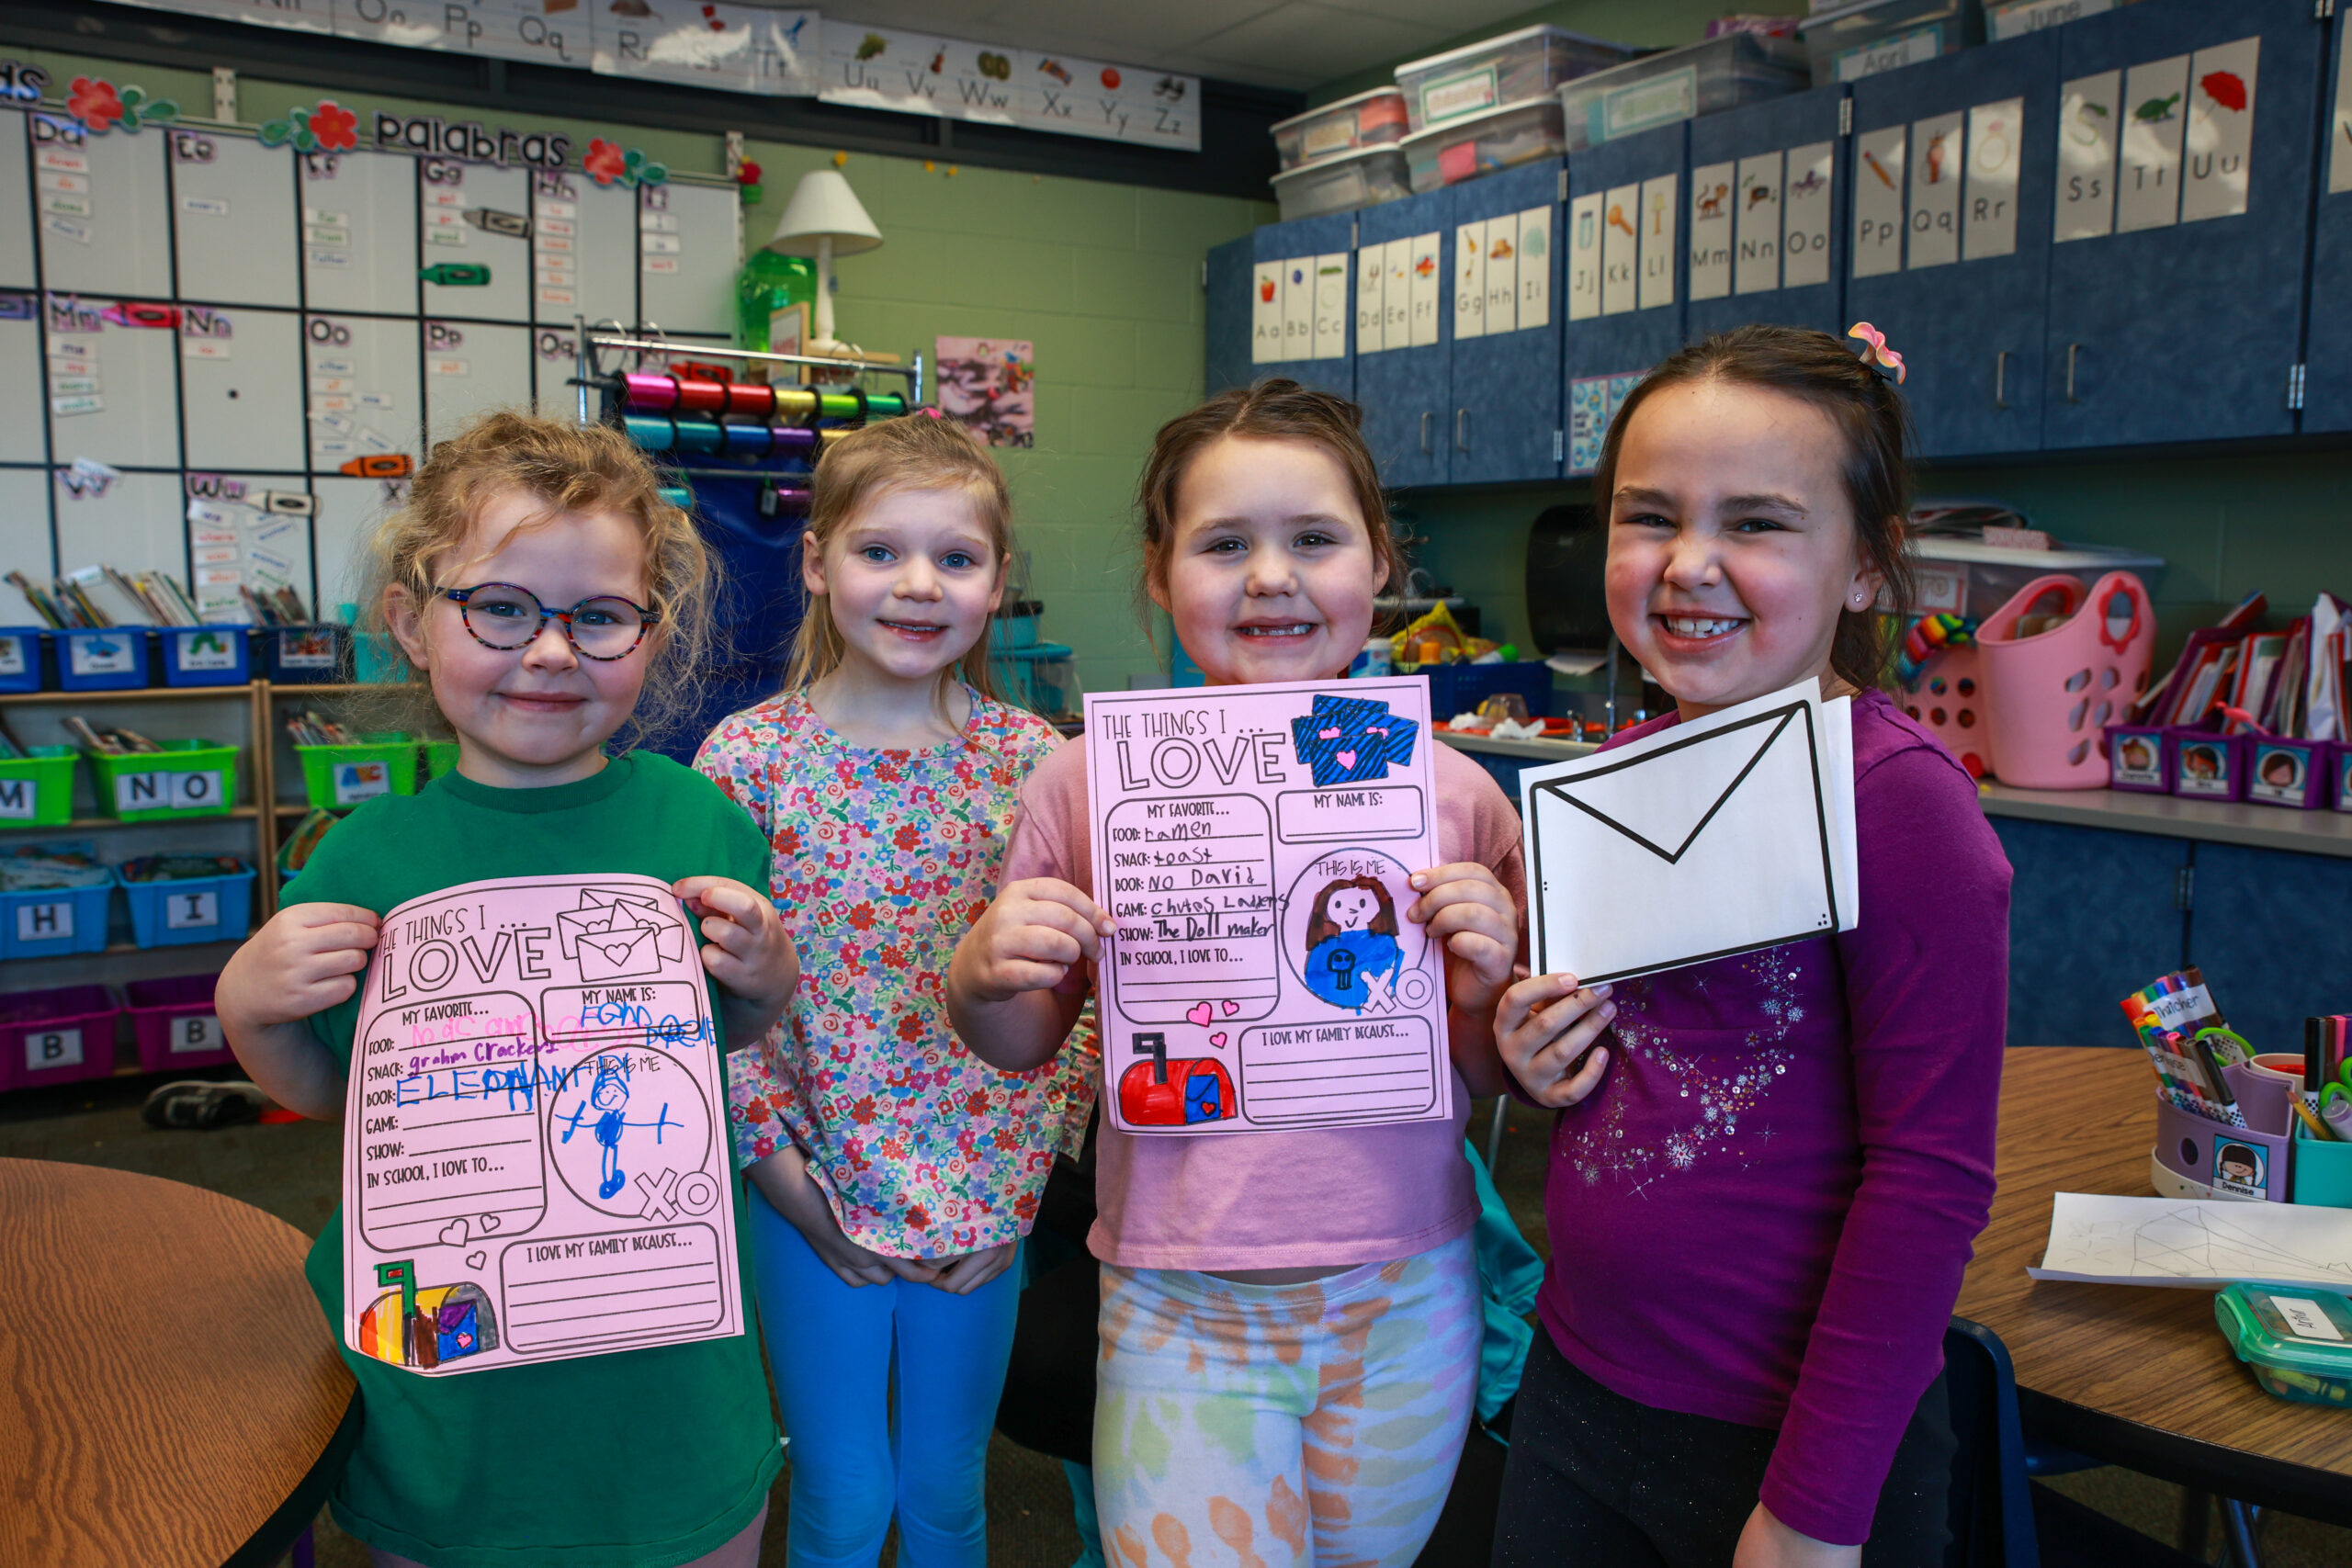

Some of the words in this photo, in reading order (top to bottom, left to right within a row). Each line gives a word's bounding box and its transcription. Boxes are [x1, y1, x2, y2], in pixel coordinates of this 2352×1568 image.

[2024, 3, 2082, 32] June
[444, 4, 483, 47] Pp
[517, 16, 572, 62] Qq
[844, 62, 879, 91] Uu
[906, 71, 935, 99] Vv
[958, 78, 1009, 108] Ww
[1043, 91, 1072, 119] Xx
[1099, 98, 1129, 136] Yy
[1155, 107, 1182, 135] Zz
[1861, 42, 1911, 74] April
[378, 114, 571, 169] palabras
[186, 309, 232, 336] Nn
[310, 320, 350, 345] Oo
[429, 324, 462, 345] Pp
[190, 476, 245, 500] Ww
[1102, 713, 1131, 740] THE
[1141, 709, 1210, 738] THINGS
[1218, 708, 1227, 735] I
[1117, 733, 1286, 792] LOVE
[0, 783, 24, 809] M
[131, 774, 157, 801] N
[185, 774, 209, 800] O
[1314, 793, 1334, 808] MY
[1337, 792, 1366, 807] NAME
[1369, 791, 1384, 807] IS:
[1148, 804, 1167, 818] MY
[1170, 800, 1230, 818] FAVORITE...
[1113, 828, 1141, 842] FOOD:
[1114, 852, 1150, 867] SNACK:
[1316, 860, 1347, 877] THIS
[1350, 860, 1363, 875] IS
[1366, 858, 1386, 875] ME
[1114, 877, 1145, 892] BOOK:
[33, 906, 57, 931] H
[186, 894, 204, 919] I
[1116, 902, 1148, 918] GAME:
[379, 927, 399, 958] THE
[405, 908, 469, 946] THINGS
[478, 904, 485, 930] I
[1118, 927, 1154, 942] SHOW:
[1153, 919, 1180, 938] The
[1186, 911, 1220, 942] Doll
[382, 927, 551, 1004] LOVE
[1120, 951, 1131, 965] IN
[1135, 949, 1177, 965] SCHOOL,
[1181, 949, 1185, 964] I
[1188, 948, 1211, 963] LOVE
[1214, 947, 1243, 962] TO...
[582, 989, 602, 1005] MY
[606, 987, 637, 1003] NAME
[641, 987, 656, 1001] IS:
[1360, 964, 1434, 1014] XO
[402, 1009, 421, 1026] MY
[424, 1000, 490, 1022] FAVORITE...
[186, 1019, 206, 1044] B
[1261, 1031, 1268, 1046] I
[1270, 1029, 1293, 1045] LOVE
[1295, 1028, 1314, 1043] MY
[1316, 1026, 1352, 1043] FAMILY
[1354, 1022, 1409, 1040] BECAUSE...
[42, 1033, 64, 1060] B
[368, 1037, 395, 1056] FOOD:
[368, 1064, 404, 1082] SNACK:
[584, 1057, 619, 1077] THIS
[639, 1055, 662, 1072] ME
[367, 1090, 397, 1108] BOOK:
[366, 1115, 399, 1134] GAME:
[367, 1142, 404, 1161] SHOW:
[367, 1172, 380, 1189] IN
[383, 1165, 430, 1186] SCHOOL,
[433, 1162, 439, 1179] I
[441, 1158, 468, 1178] LOVE
[471, 1156, 505, 1173] TO...
[634, 1168, 719, 1223] XO
[2222, 1181, 2255, 1196] Dennise
[527, 1247, 533, 1263] I
[536, 1244, 562, 1263] LOVE
[565, 1241, 585, 1259] MY
[588, 1236, 629, 1257] FAMILY
[632, 1232, 693, 1252] BECAUSE...
